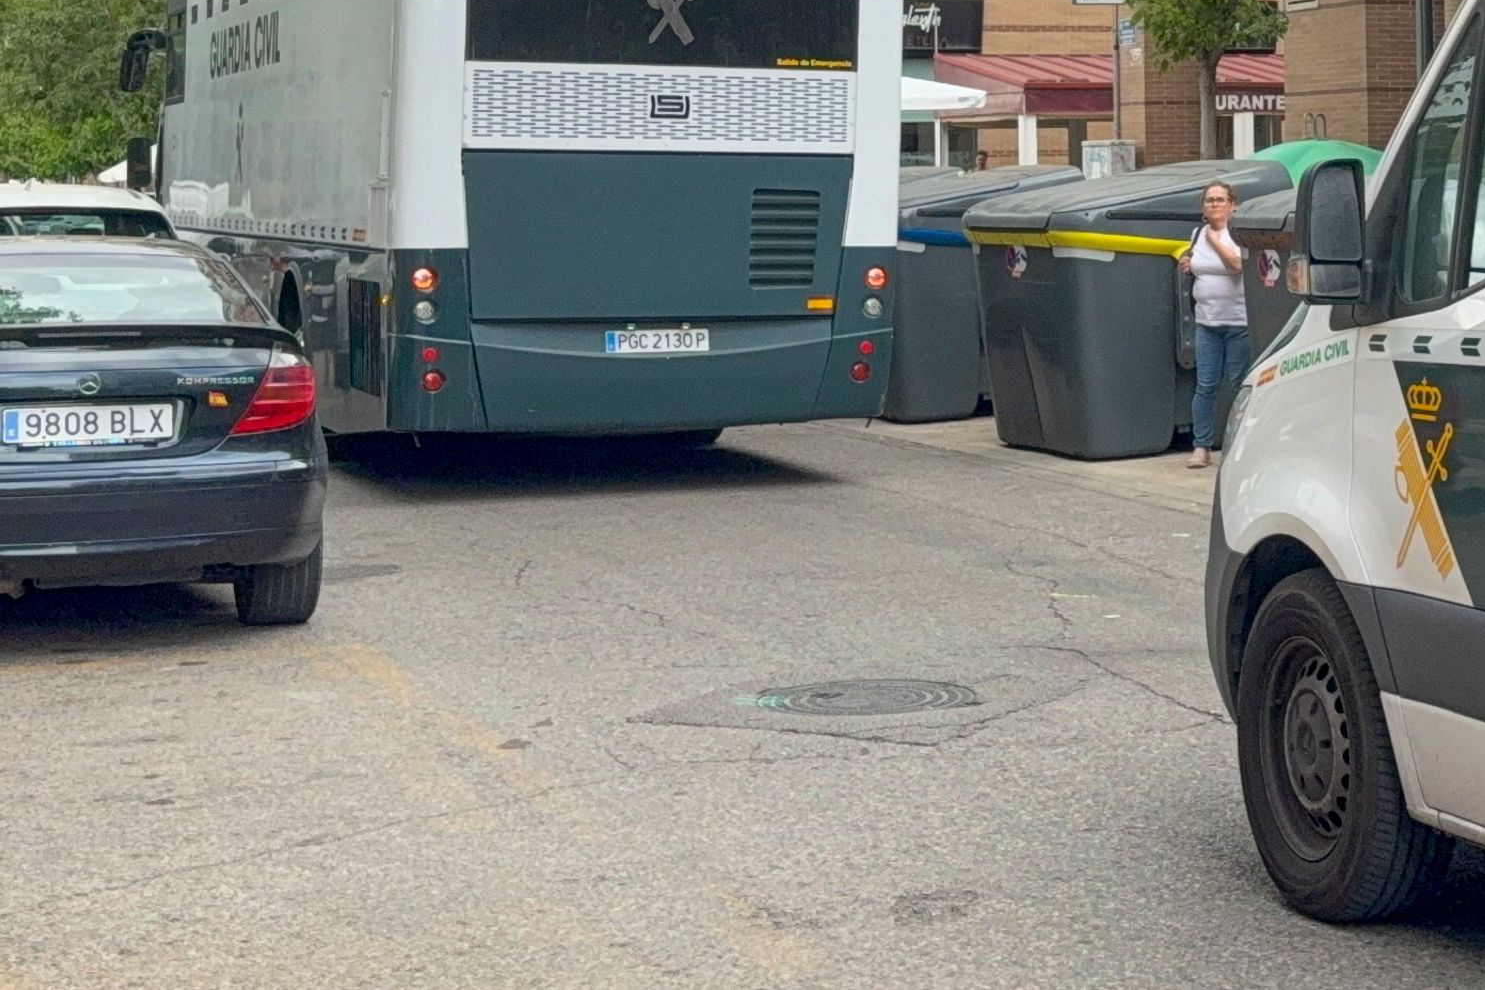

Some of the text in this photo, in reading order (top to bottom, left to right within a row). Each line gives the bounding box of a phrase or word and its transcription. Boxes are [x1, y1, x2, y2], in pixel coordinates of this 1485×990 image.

[209, 10, 281, 80] GUARDIA CIVIL
[1215, 94, 1286, 111] URANTE
[618, 333, 705, 349] PGC 2130 P
[1280, 339, 1349, 376] GUARDIA CIVIL
[176, 376, 255, 386] KOMPRESSOR
[25, 408, 165, 438] 9808 BLX
